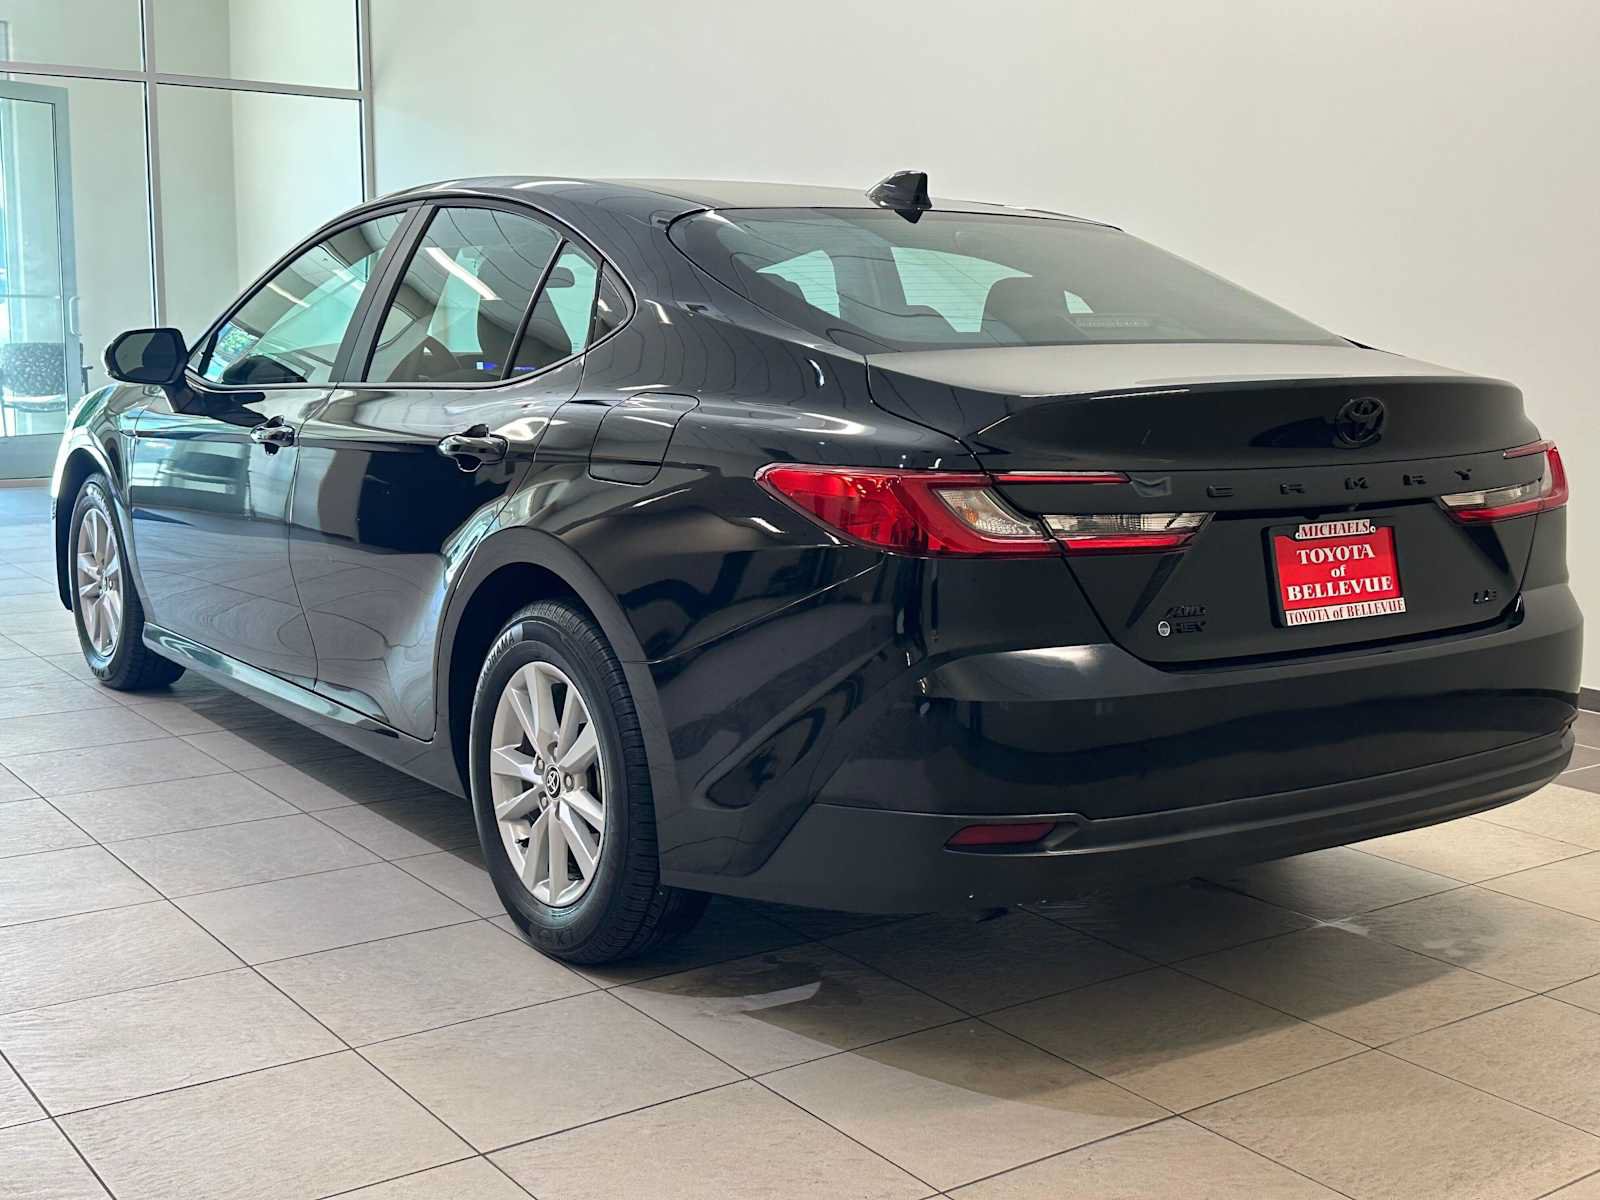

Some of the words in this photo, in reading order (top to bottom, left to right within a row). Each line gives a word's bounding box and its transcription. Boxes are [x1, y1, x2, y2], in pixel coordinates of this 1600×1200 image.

[1300, 521, 1369, 538] MICHAELS
[1296, 543, 1375, 565] TOYOTA
[1330, 564, 1346, 578] of
[1286, 576, 1393, 601] BELLEVUE
[1288, 609, 1330, 625] TOYOTA
[1333, 607, 1345, 619] of
[1346, 599, 1404, 618] BELLEVUE
